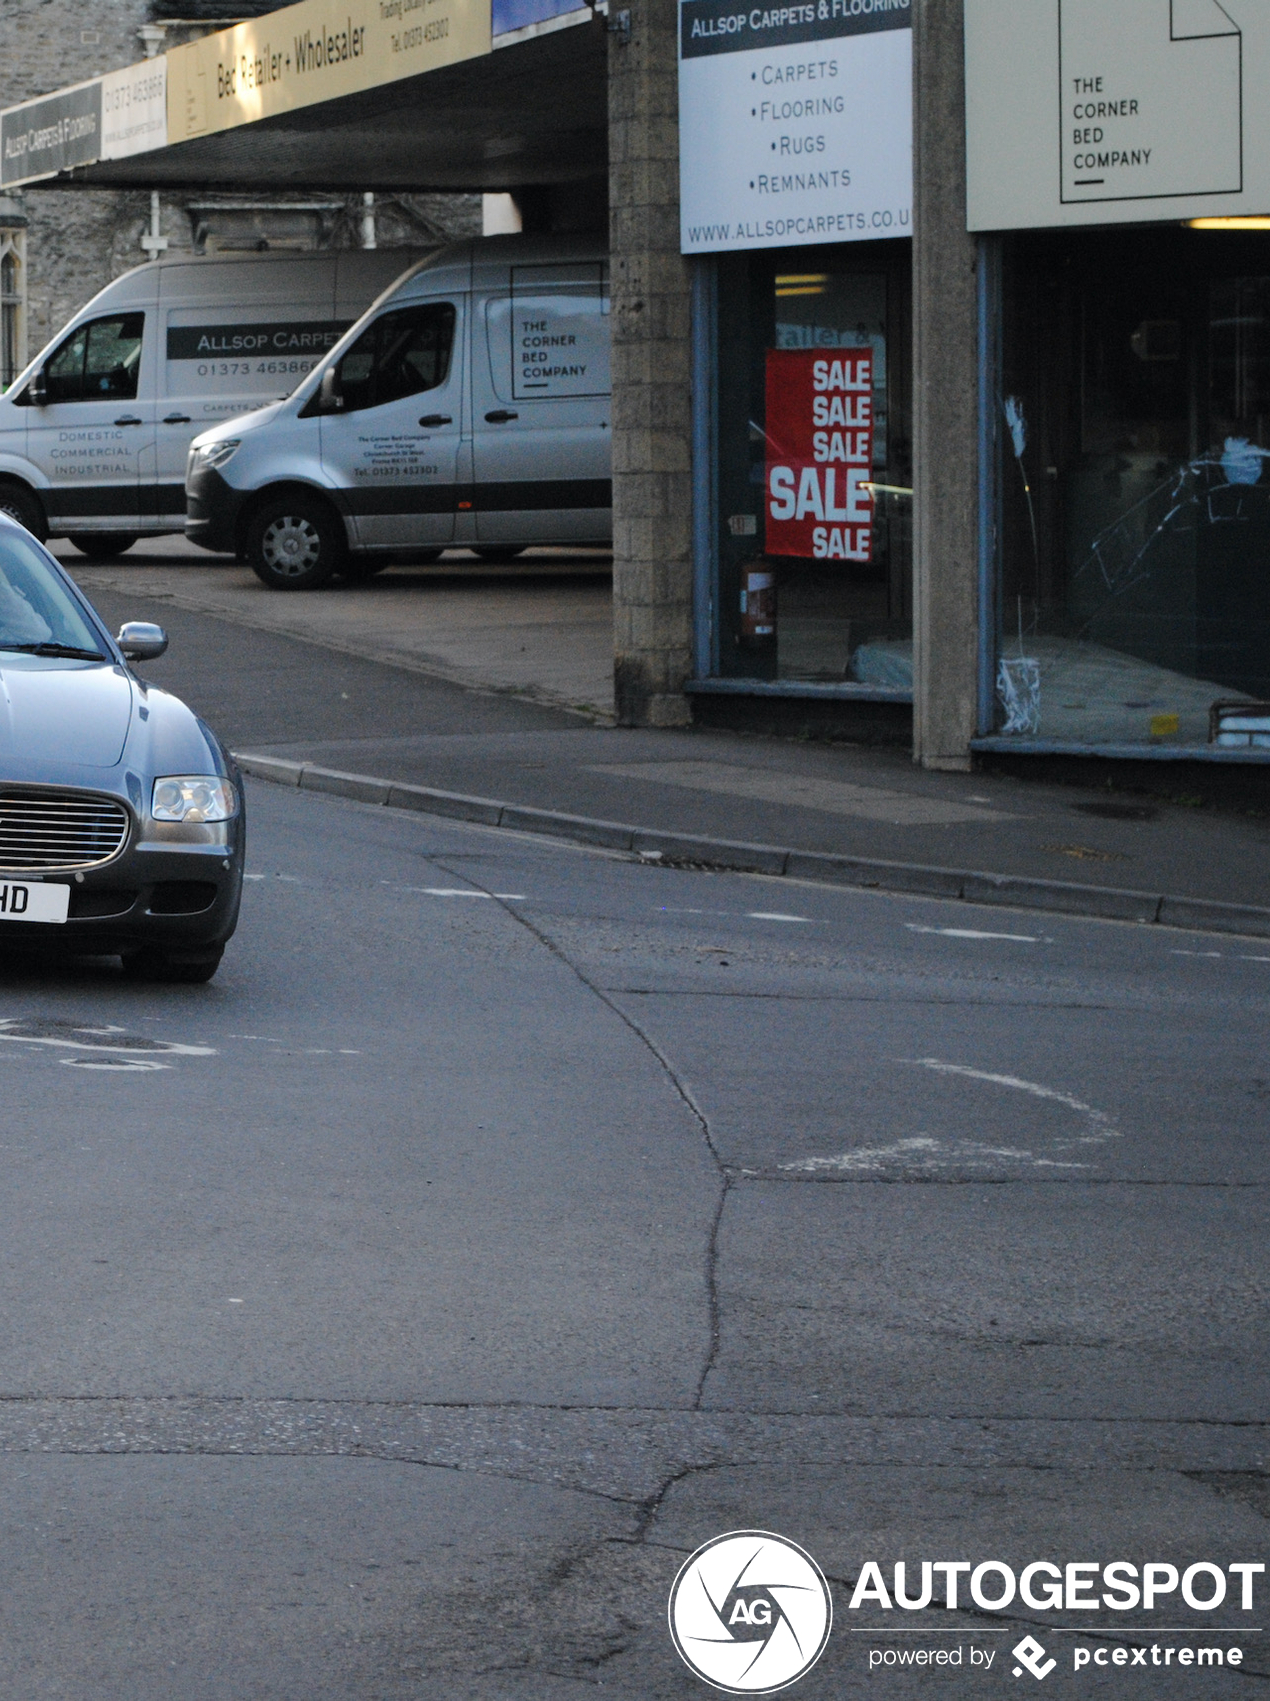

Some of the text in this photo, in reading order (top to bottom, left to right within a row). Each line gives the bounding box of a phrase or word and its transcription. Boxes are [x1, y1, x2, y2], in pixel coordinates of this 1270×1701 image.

[691, 14, 746, 38] ALLSOP
[749, 5, 815, 30] CARPETS
[817, 0, 829, 20] &
[241, 43, 282, 89] Retailer
[294, 16, 365, 74] Wholesaler
[761, 60, 838, 85] CARPETS
[1073, 77, 1103, 94] THE
[760, 96, 845, 121] FLOORING
[1073, 99, 1138, 119] CORNER
[780, 135, 826, 155] RUGS
[1073, 127, 1104, 145] BED
[1073, 148, 1152, 169] COMPANY
[758, 169, 851, 194] REMNANTS
[522, 321, 548, 332] THE
[197, 334, 269, 350] ALLSOP
[522, 335, 576, 347] CORNER
[522, 351, 548, 363] BED
[197, 362, 250, 376] 01373
[522, 365, 587, 378] COMPANY
[812, 360, 871, 391] SALE
[812, 396, 871, 427] SALE
[59, 430, 124, 442] DOMESTIC
[50, 447, 132, 459] COMMERCIAL
[812, 431, 870, 463] SALE
[55, 463, 130, 475] INDUSTRIAL
[769, 466, 871, 523] SALE
[812, 526, 870, 560] SALE
